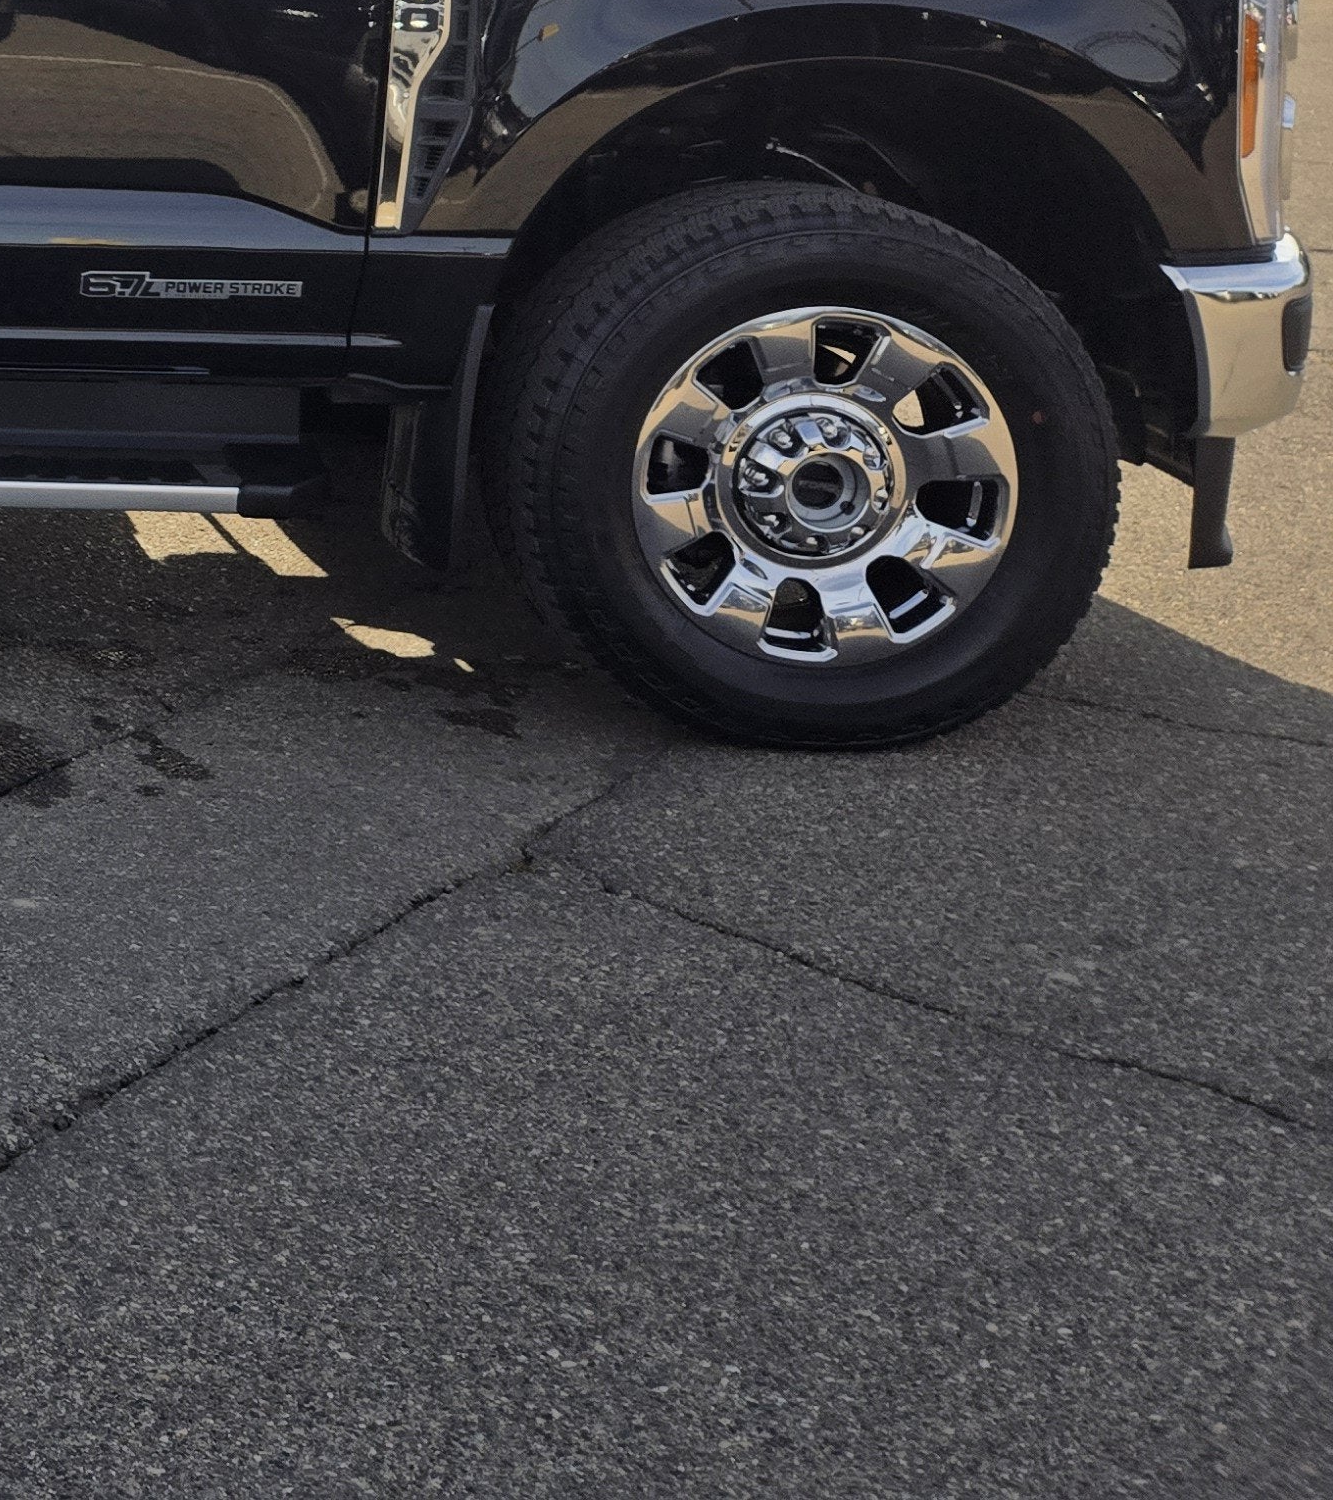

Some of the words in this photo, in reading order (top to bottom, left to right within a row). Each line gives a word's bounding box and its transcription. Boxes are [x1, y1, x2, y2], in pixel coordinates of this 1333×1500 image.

[80, 272, 161, 297] 6.7L
[164, 281, 224, 294] POWER
[228, 282, 298, 295] STROKE
